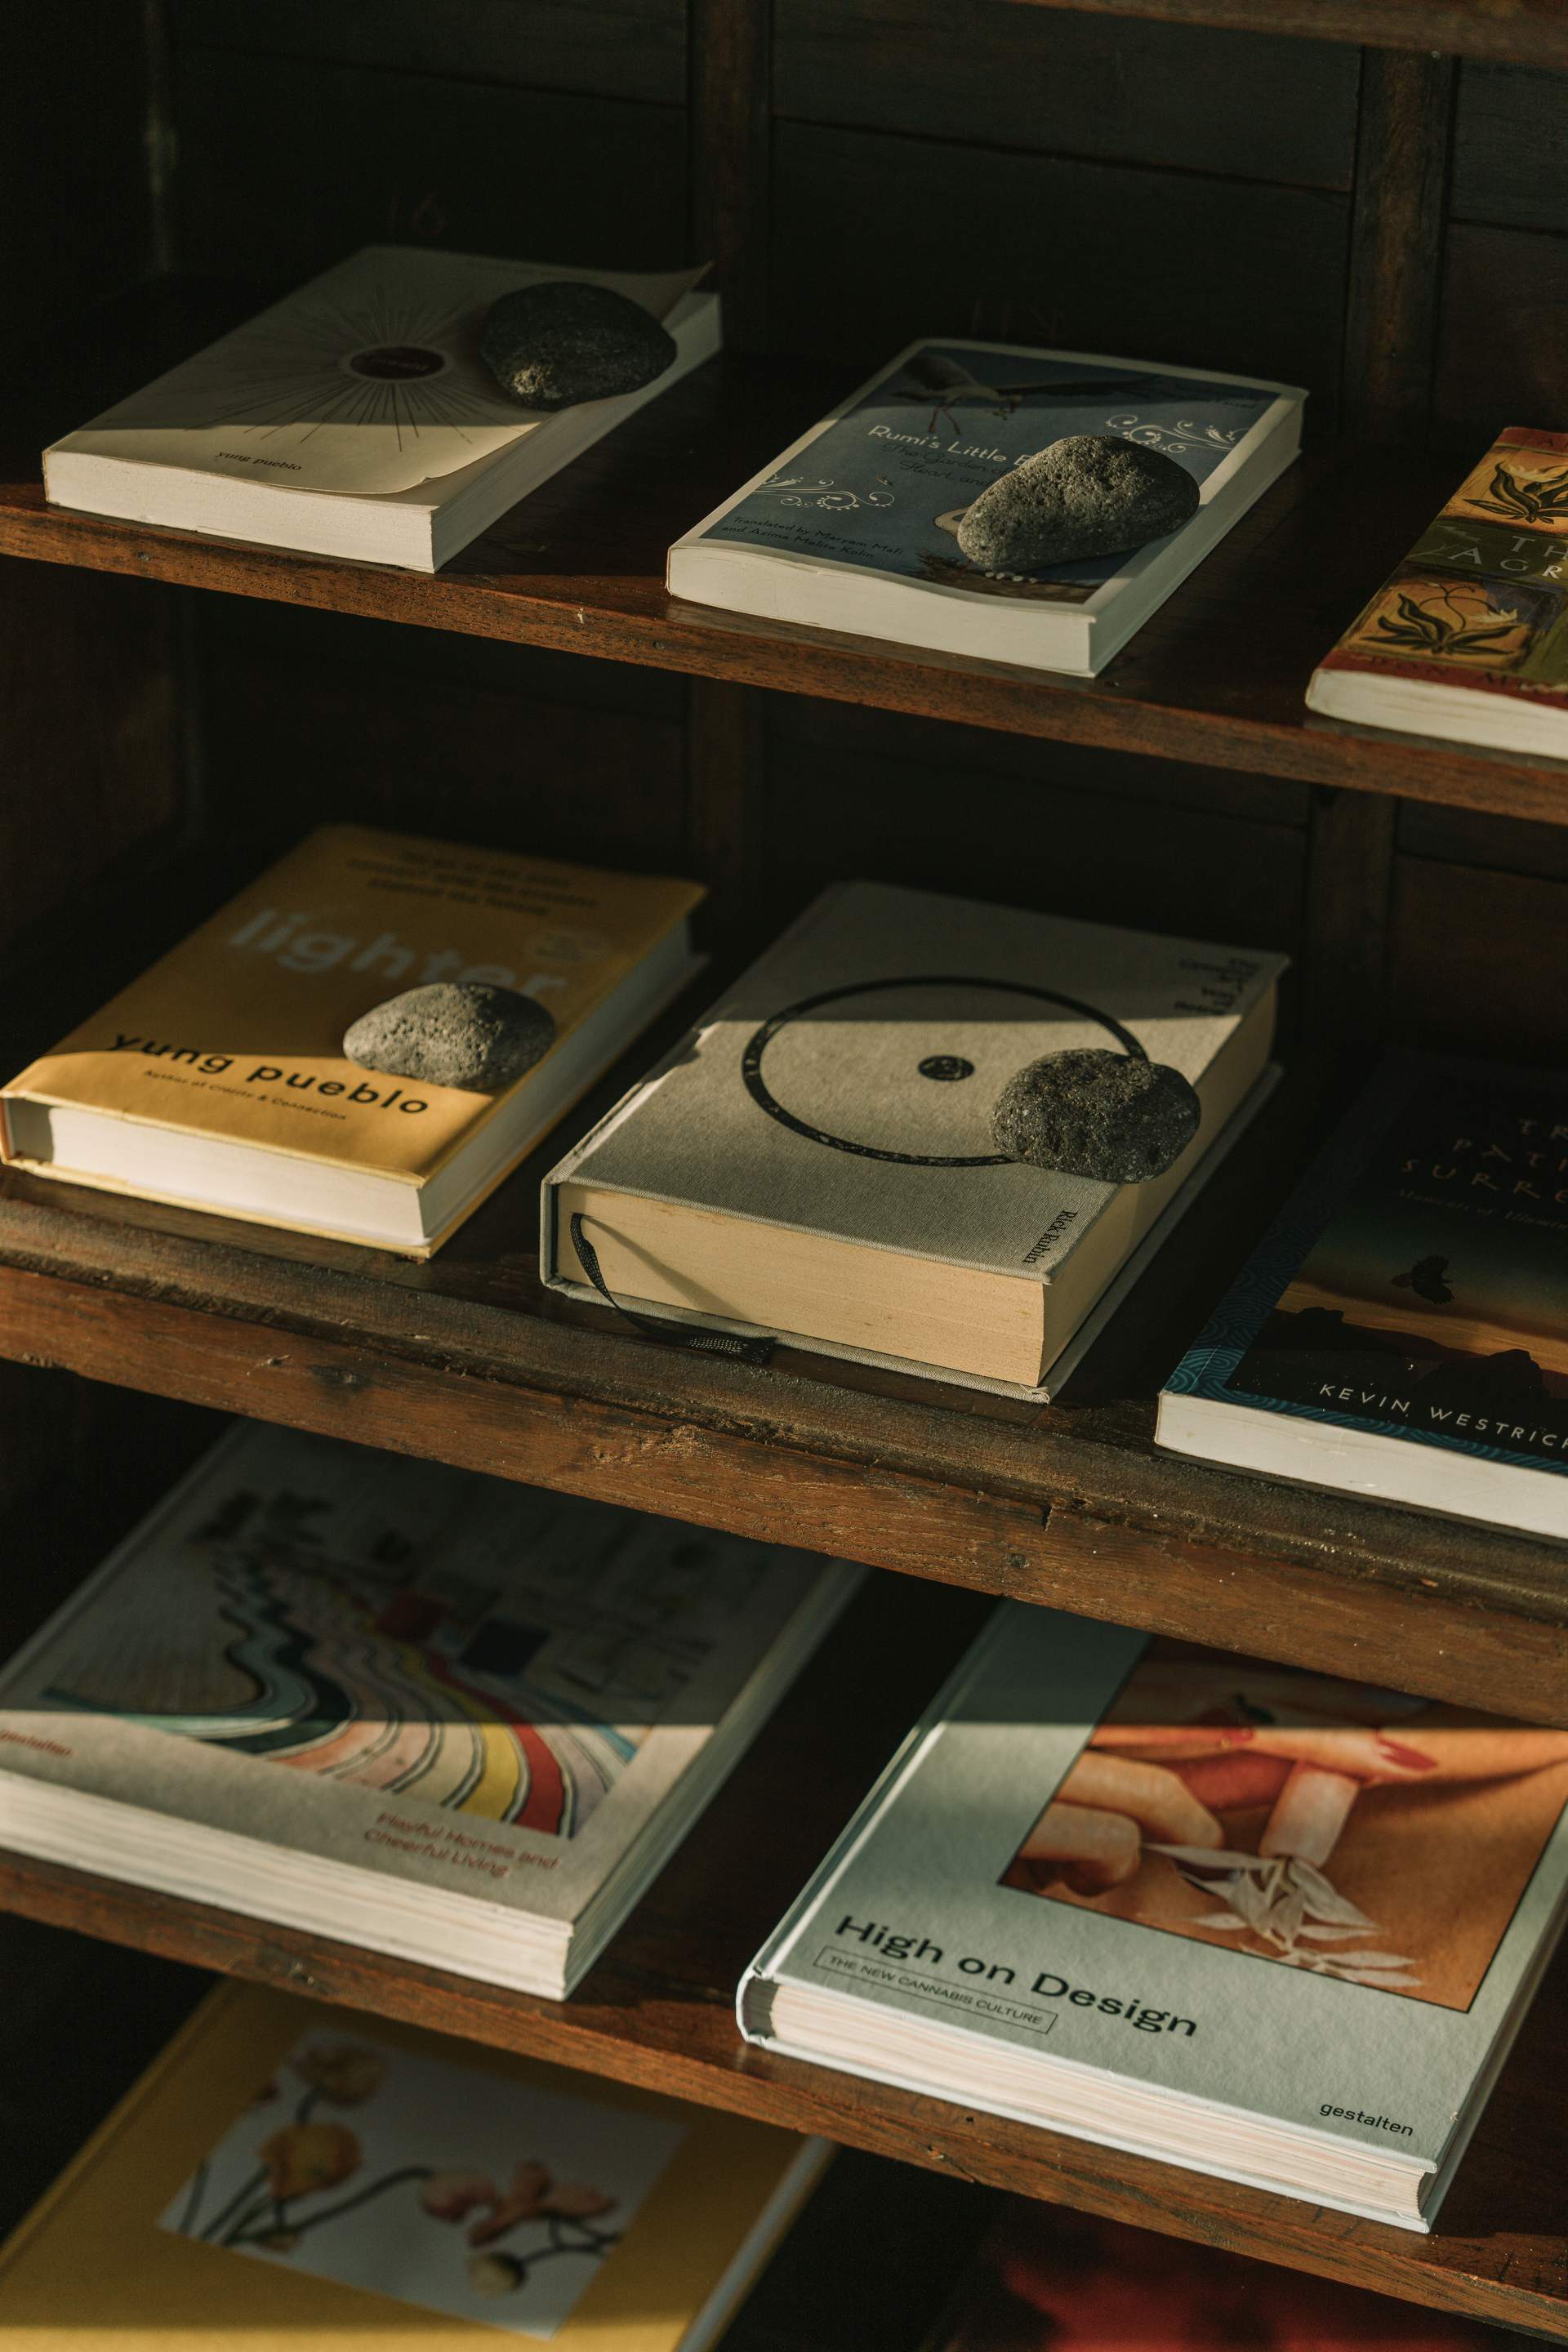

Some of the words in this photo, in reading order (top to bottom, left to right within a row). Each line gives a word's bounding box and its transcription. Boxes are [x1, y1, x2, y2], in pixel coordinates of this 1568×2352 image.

[214, 451, 252, 462] yung
[253, 458, 301, 470] pueblo
[867, 425, 942, 449] Rumi's
[947, 441, 1007, 462] Little
[883, 442, 918, 457] The
[924, 452, 986, 471] Garden
[733, 516, 796, 531] Translated
[797, 525, 810, 536] by
[816, 530, 866, 548] Maryam
[1447, 546, 1562, 580] AGR
[229, 906, 568, 998] lighter
[109, 1033, 234, 1074] yung
[246, 1063, 428, 1114] pueblo
[1046, 1210, 1078, 1232] Rick
[1022, 1232, 1061, 1263] Rubin
[1319, 1383, 1410, 1413] KEVIN
[364, 1828, 448, 1860] Cheerful
[452, 1850, 510, 1878] Living
[376, 1811, 445, 1838] Playful
[446, 1829, 515, 1858] Homes
[518, 1851, 559, 1869] and
[828, 1955, 857, 1970] THE
[861, 1965, 897, 1982] NEW
[898, 1976, 973, 2004] CANNABIS
[976, 1998, 1045, 2025] CULTURE
[833, 1914, 945, 1964] High
[957, 1956, 1016, 1985] on
[1030, 1971, 1198, 2038] Design
[1319, 2104, 1414, 2136] gestalten
